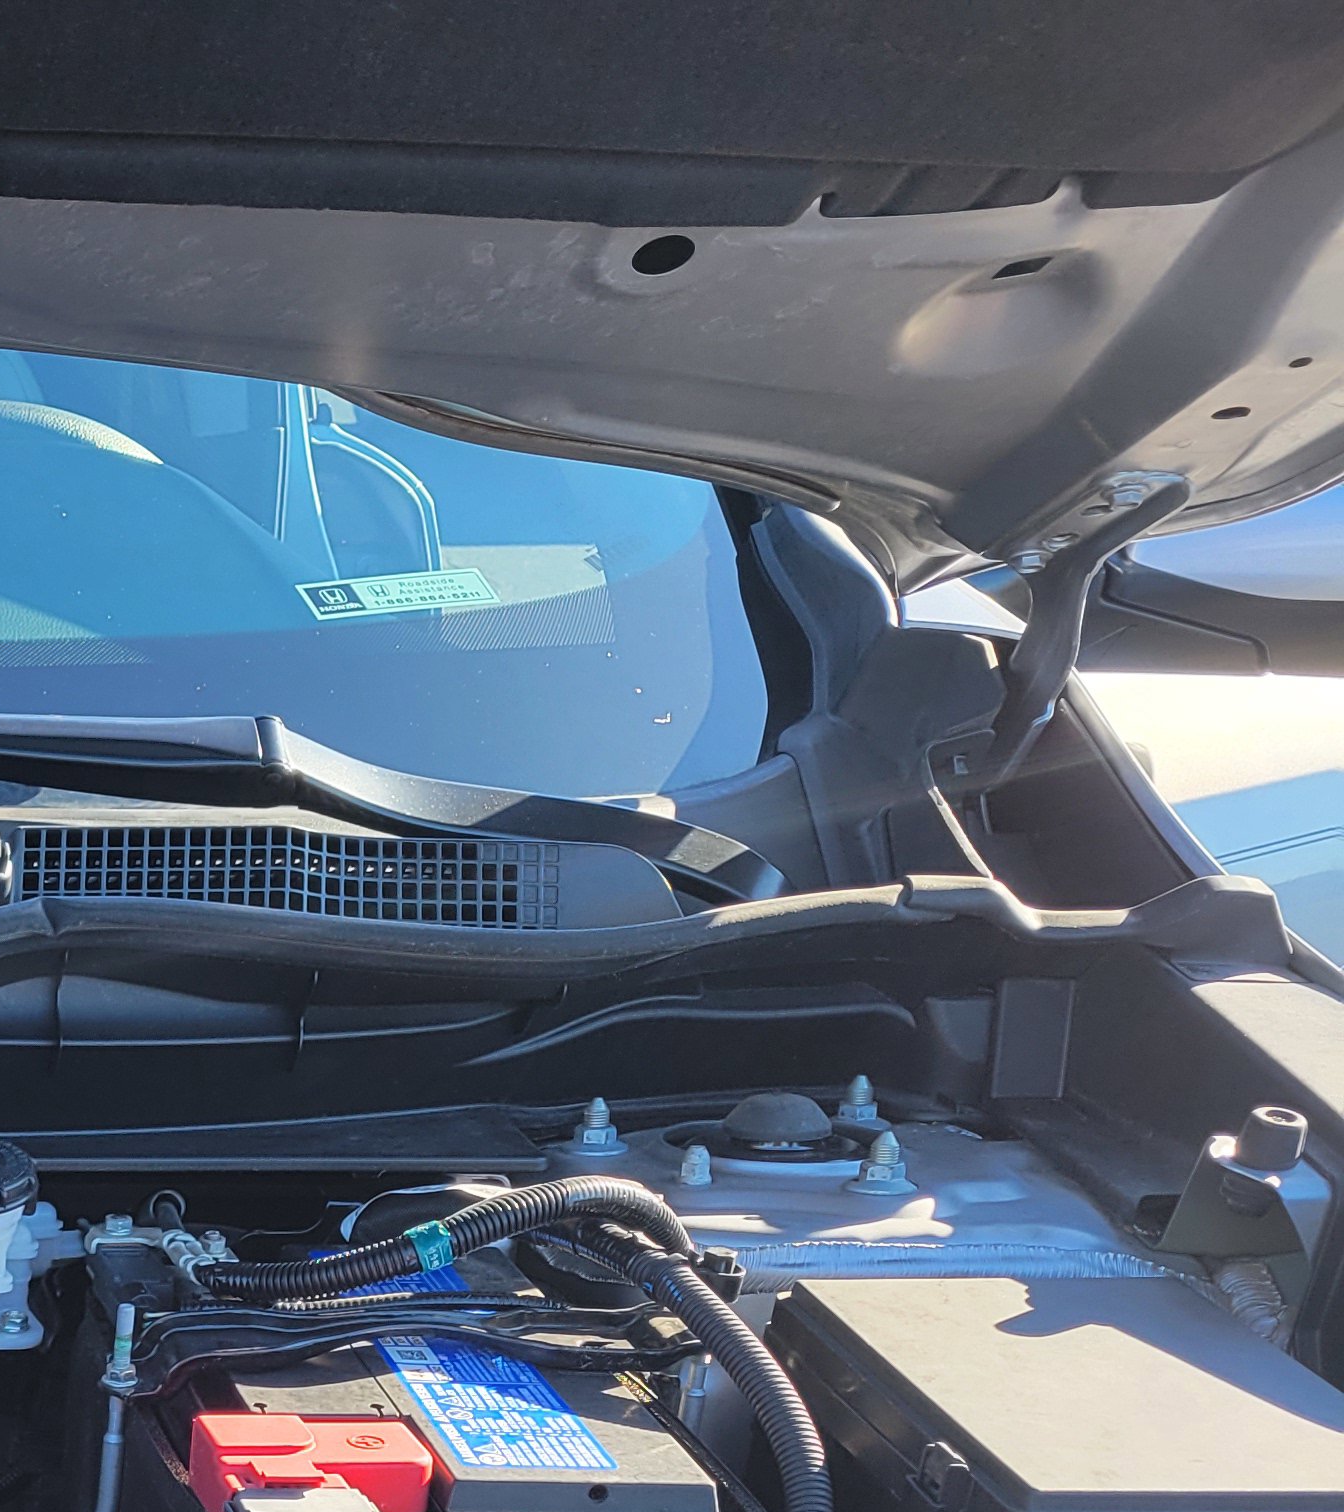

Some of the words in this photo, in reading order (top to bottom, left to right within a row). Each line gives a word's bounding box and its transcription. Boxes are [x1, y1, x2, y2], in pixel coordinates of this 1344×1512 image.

[398, 577, 455, 588] Roadside
[399, 584, 465, 595] Assistance
[319, 601, 363, 612] HONDA
